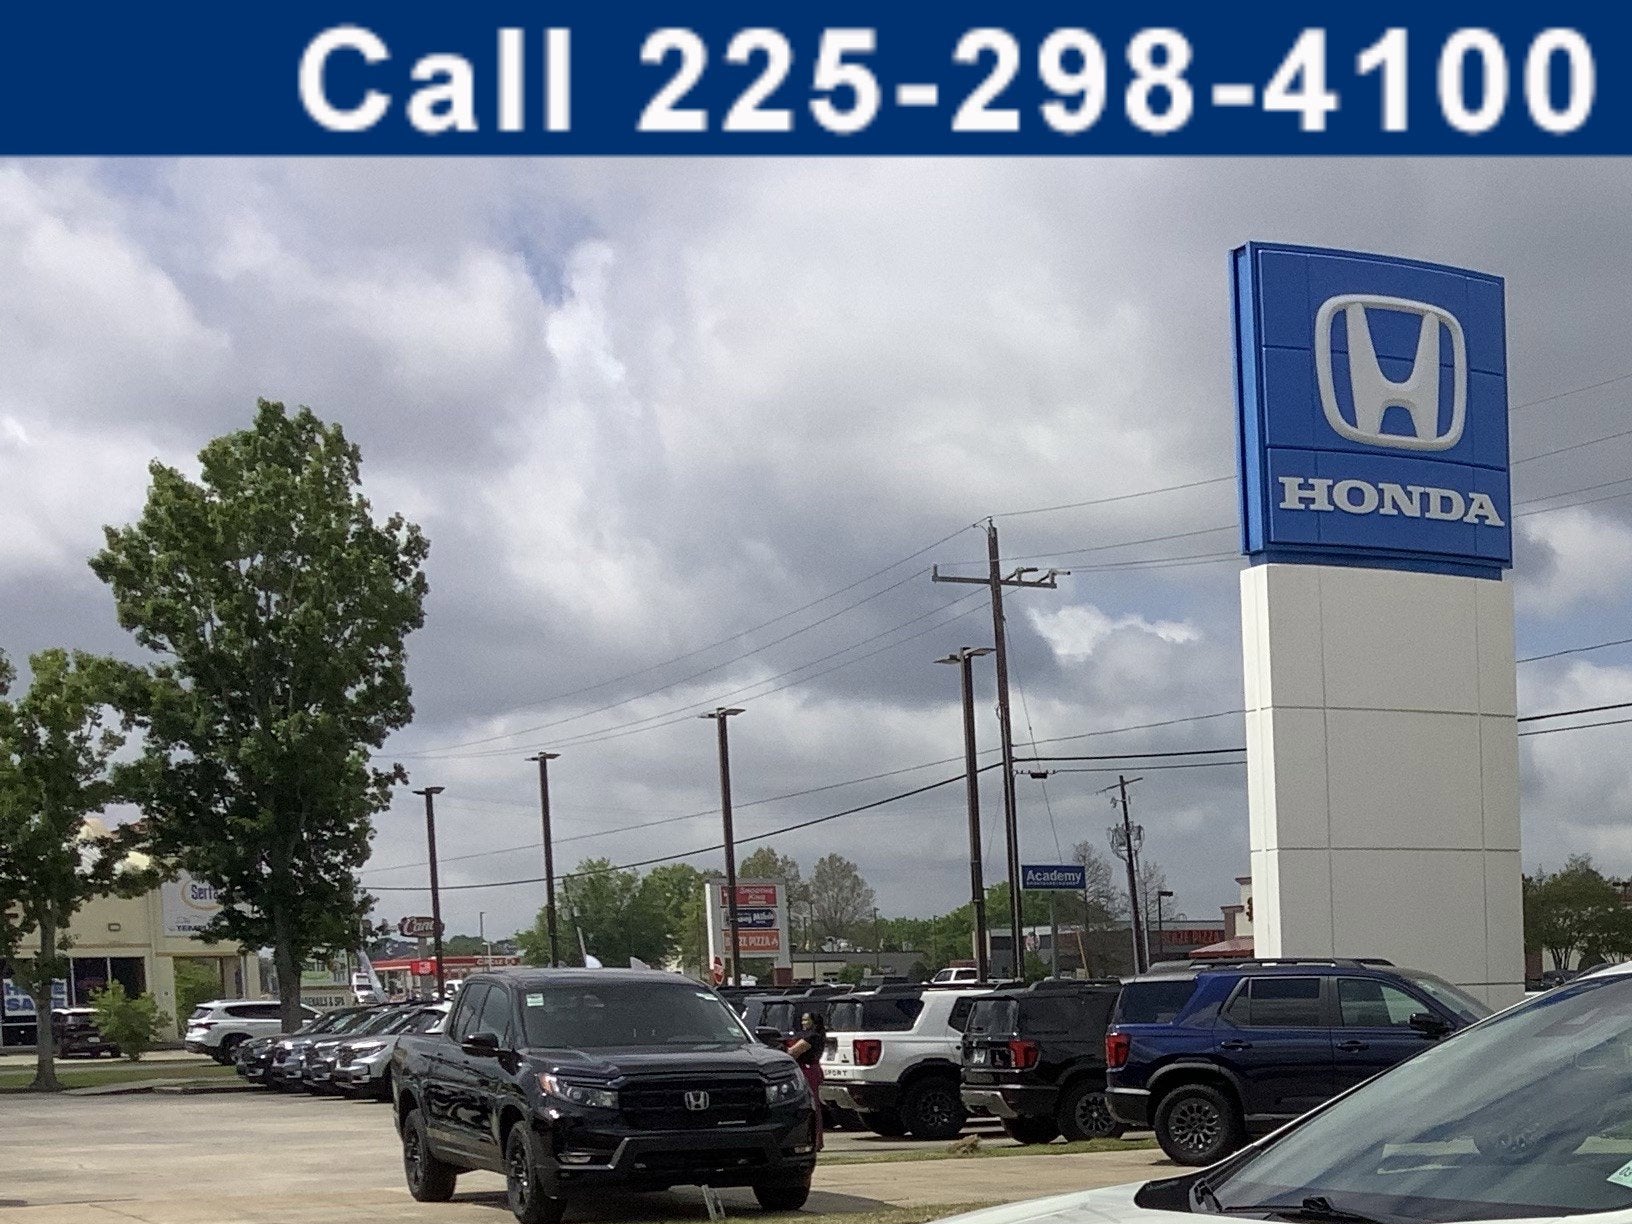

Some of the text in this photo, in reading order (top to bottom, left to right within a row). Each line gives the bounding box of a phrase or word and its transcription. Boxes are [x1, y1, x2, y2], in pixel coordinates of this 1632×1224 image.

[1278, 476, 1505, 527] HONDA
[1026, 870, 1082, 885] Academy
[749, 935, 771, 947] PIZZA
